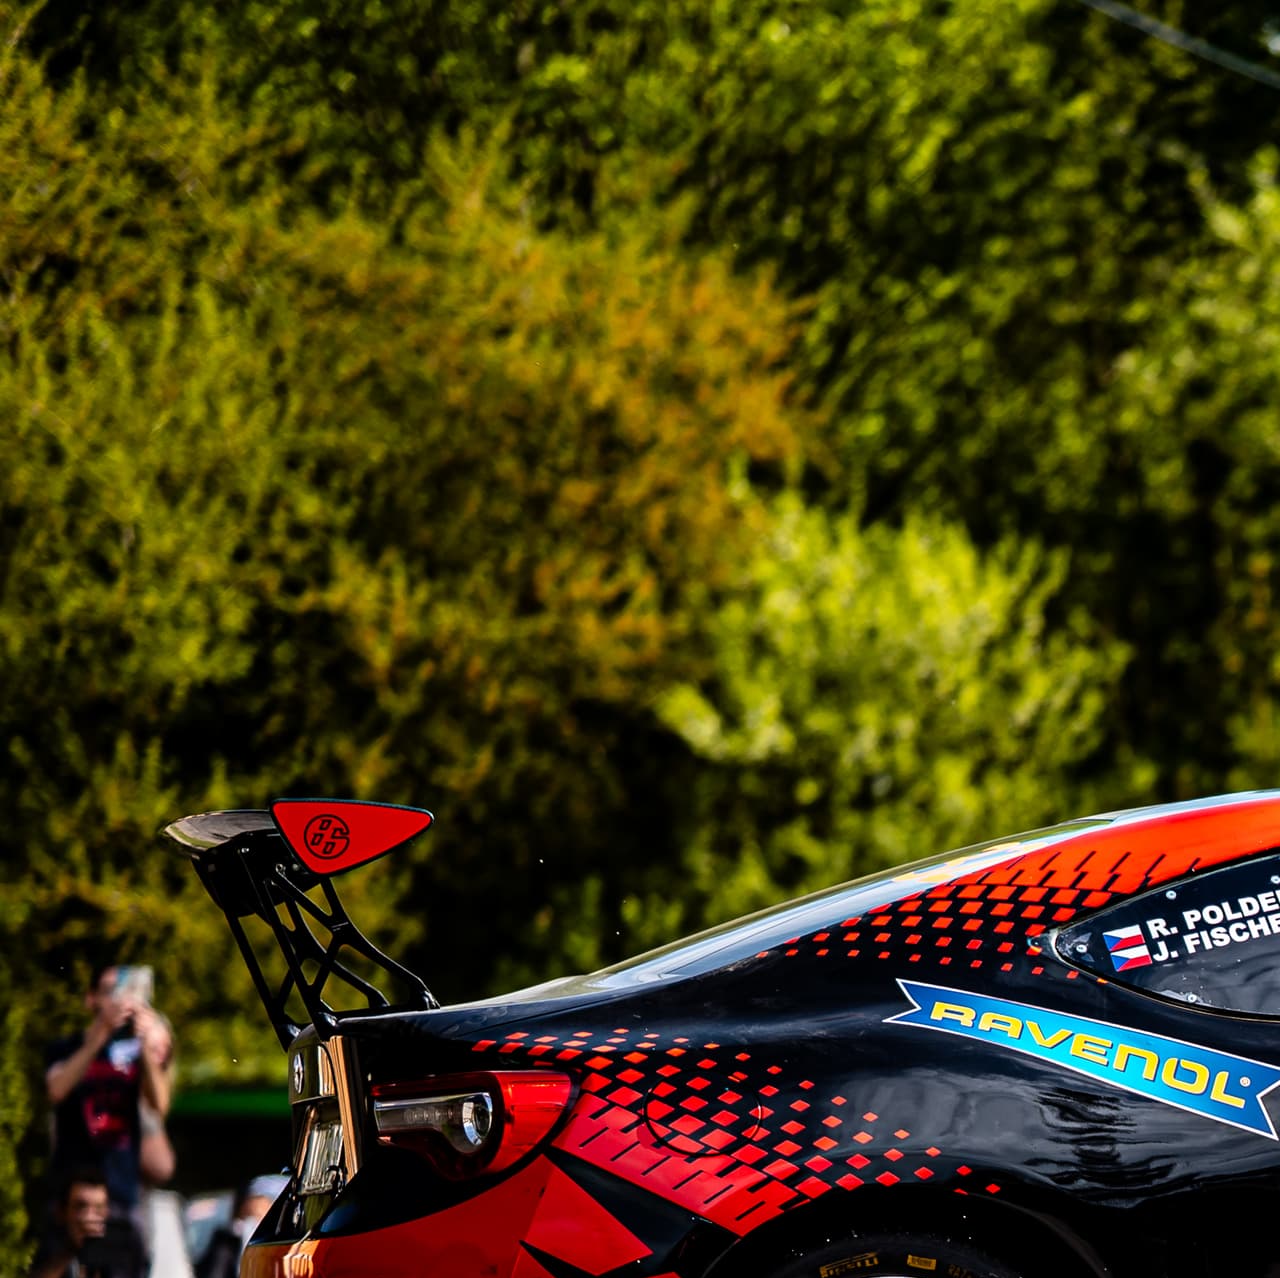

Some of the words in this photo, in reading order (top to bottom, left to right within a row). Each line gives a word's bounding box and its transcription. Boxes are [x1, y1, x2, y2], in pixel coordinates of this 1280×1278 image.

[1146, 918, 1179, 940] R.
[1152, 941, 1179, 962] J.
[929, 1001, 1246, 1109] RAVENOL
